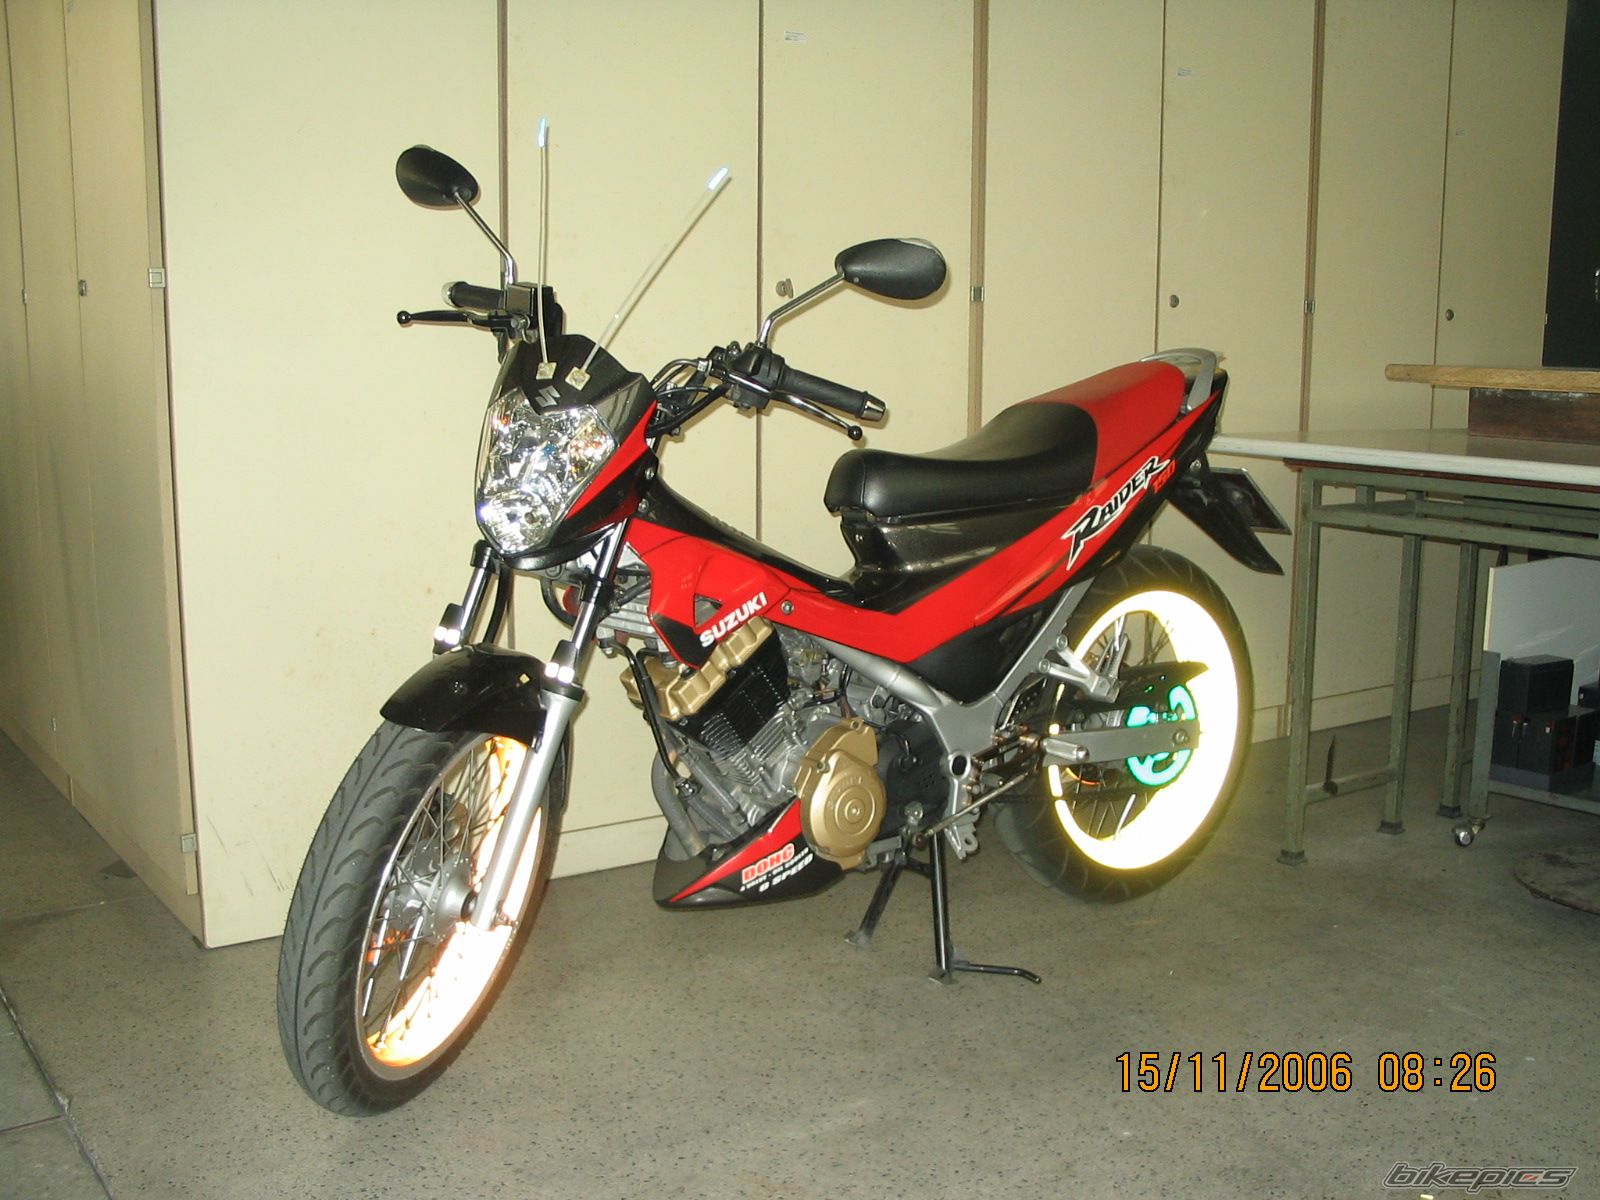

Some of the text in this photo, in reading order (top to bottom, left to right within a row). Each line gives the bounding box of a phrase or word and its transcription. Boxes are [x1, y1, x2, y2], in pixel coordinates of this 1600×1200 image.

[1060, 455, 1171, 571] RAIDER
[699, 591, 768, 648] SUZUKI
[741, 843, 795, 885] DOHC
[772, 853, 814, 886] SPEED
